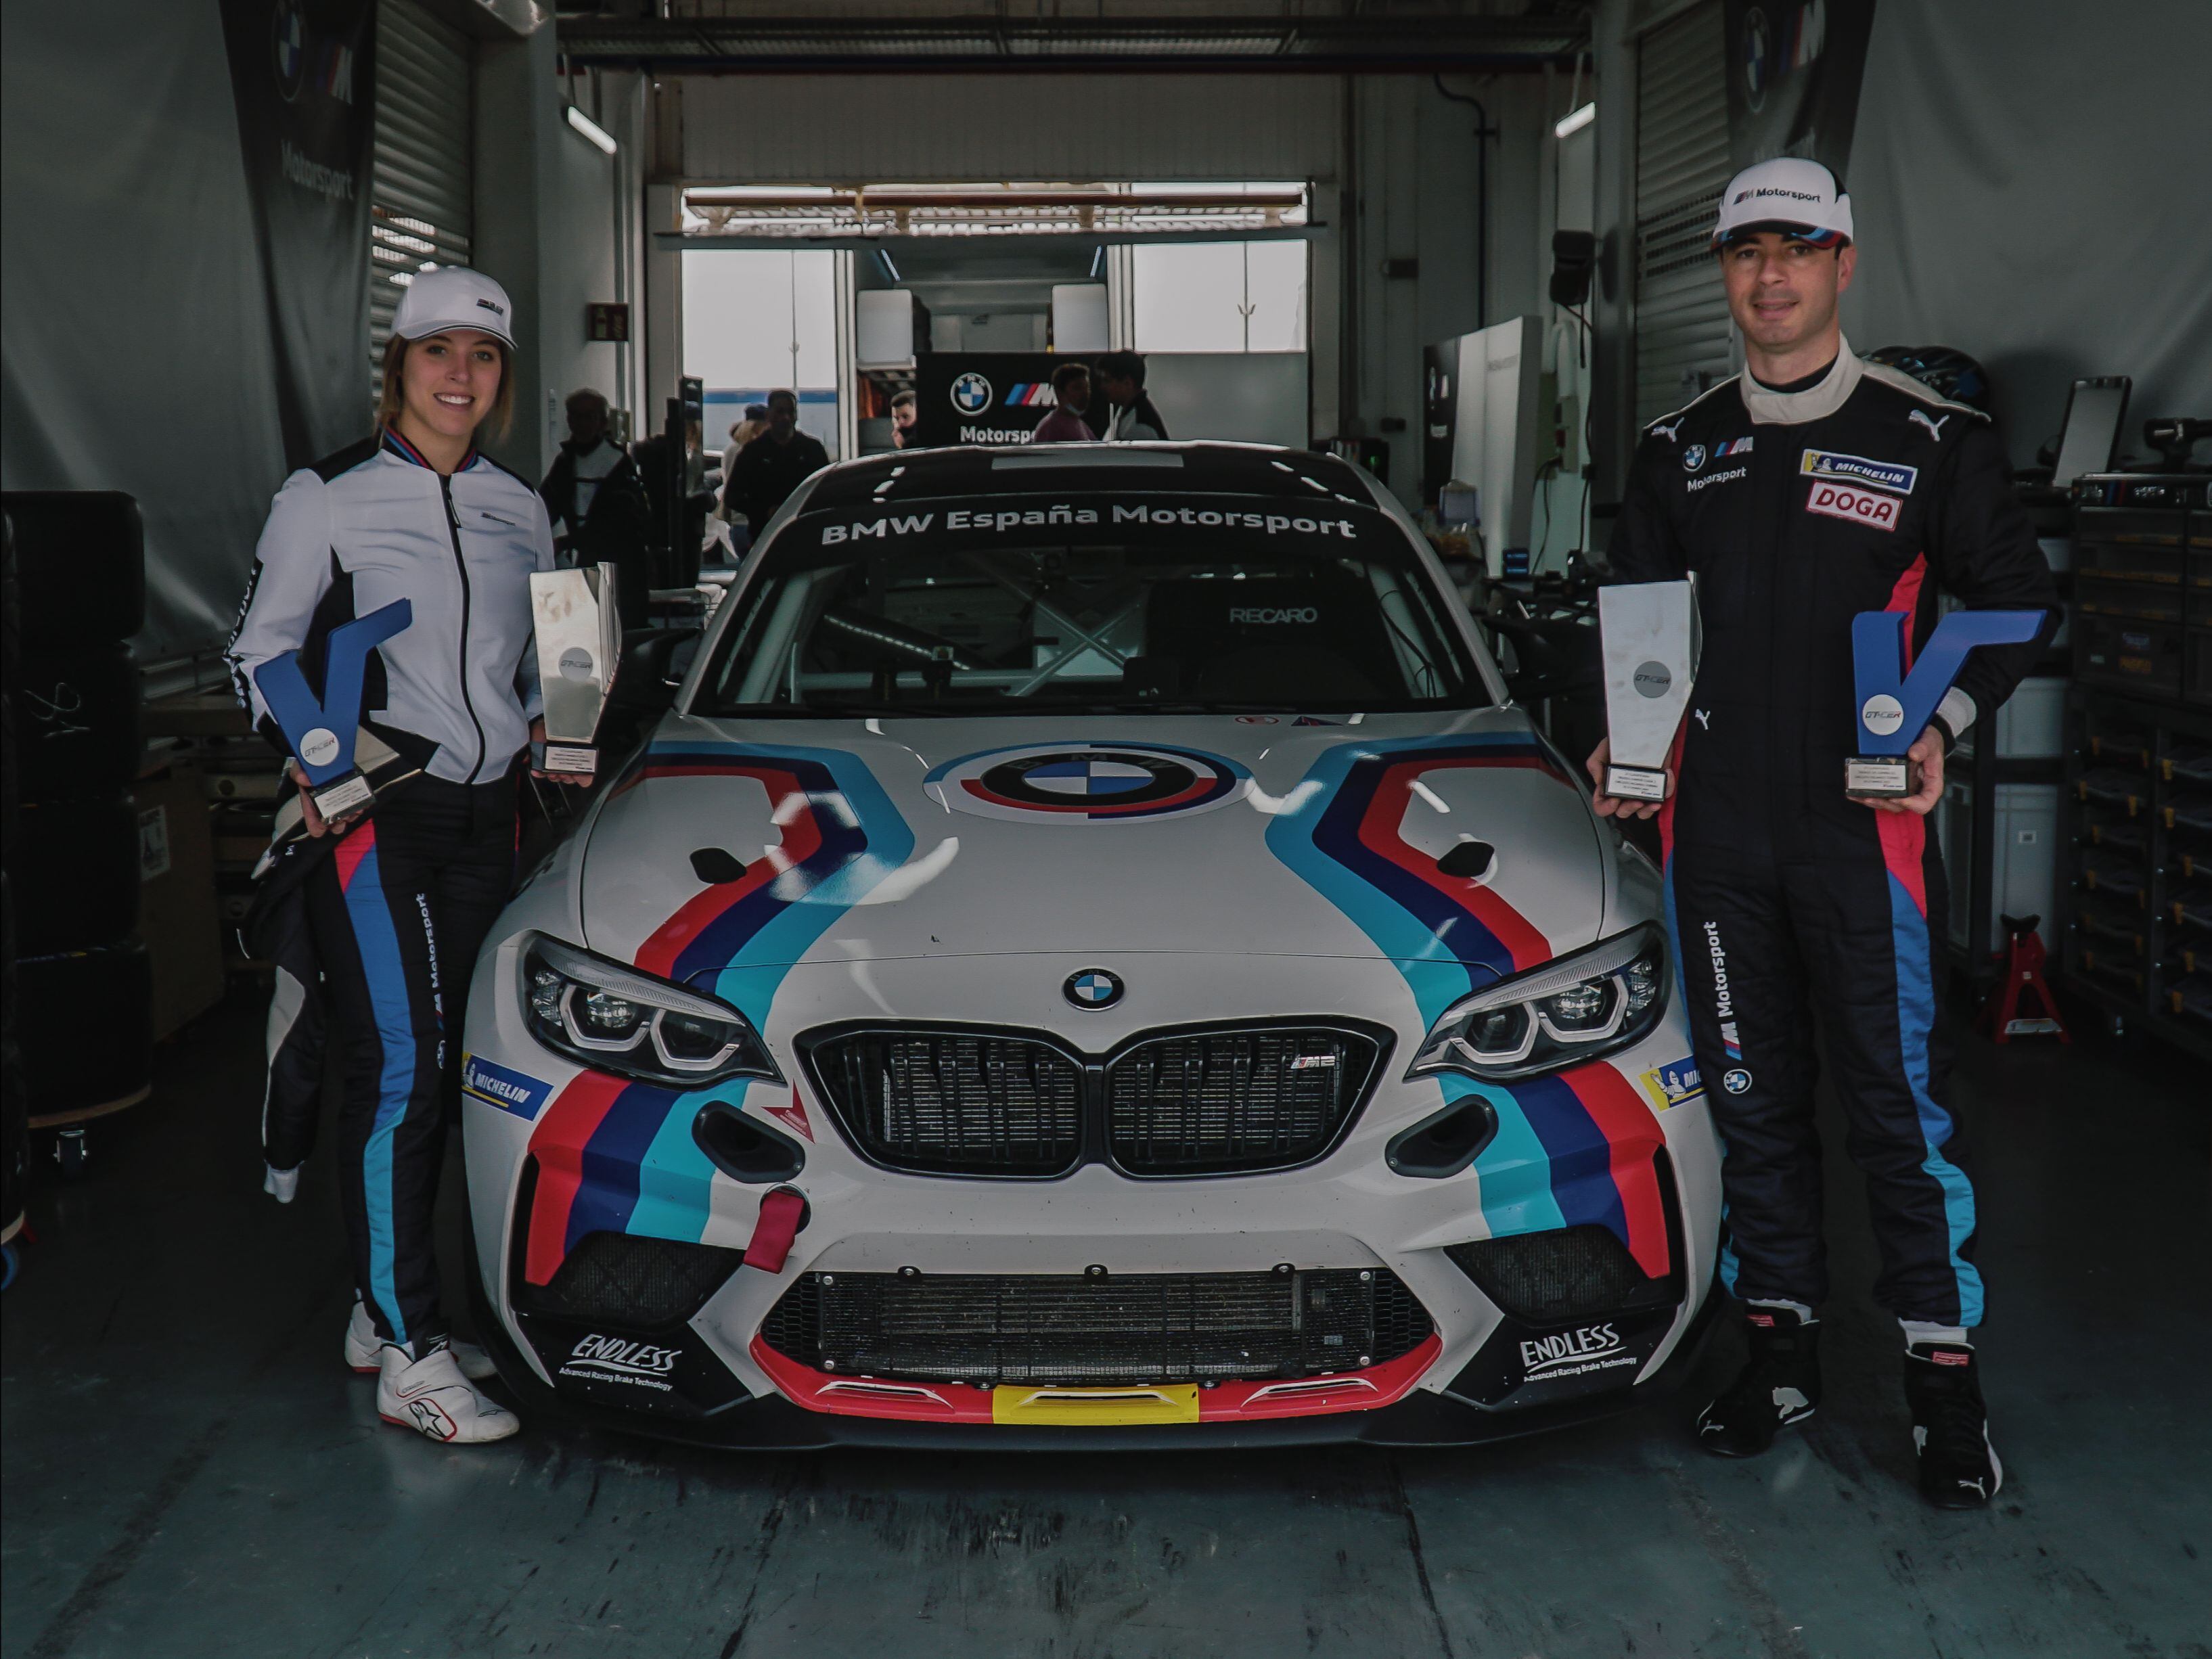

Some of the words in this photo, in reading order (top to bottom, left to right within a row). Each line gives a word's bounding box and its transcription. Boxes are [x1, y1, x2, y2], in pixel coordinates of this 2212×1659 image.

[281, 138, 353, 201] Motorsport
[1756, 187, 1821, 203] Motorsport
[1834, 462, 1905, 483] MICHELIN
[1815, 488, 1893, 522] DOGA
[821, 513, 934, 545] BMW
[947, 503, 1098, 532] España
[1112, 504, 1357, 539] Motorsport
[1229, 607, 1318, 623] RECARO
[415, 892, 438, 988] Motorsport
[1703, 921, 1734, 1018] Motorsport
[474, 1072, 531, 1104] MICHELIN
[571, 1333, 683, 1371] ENDLESS
[1520, 1323, 1621, 1367] ENDLESS
[559, 1367, 591, 1378] Advanced
[591, 1371, 614, 1383] Racing
[614, 1374, 633, 1384] Brake
[635, 1376, 673, 1392] Technology
[1524, 1369, 1557, 1382] Advanced
[1558, 1365, 1581, 1376] Racing
[1581, 1363, 1601, 1372] Brake
[1601, 1357, 1638, 1368] Technology
